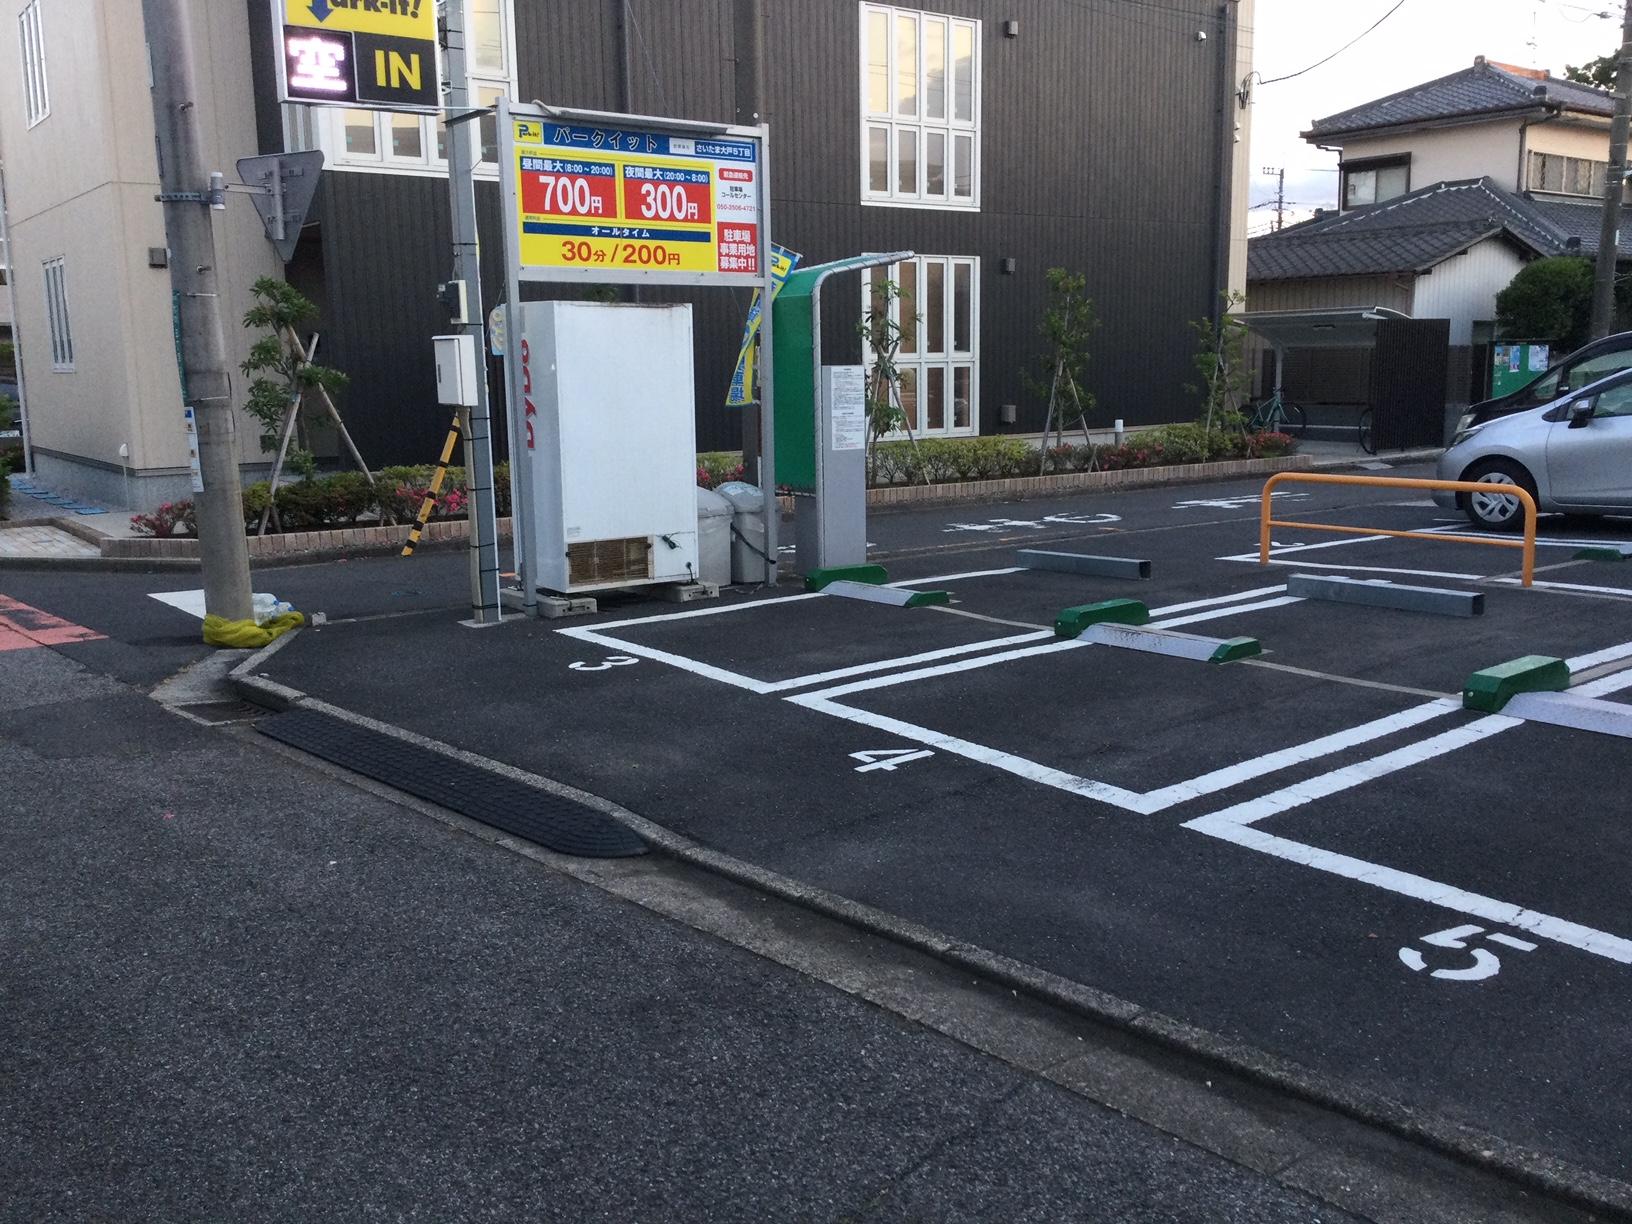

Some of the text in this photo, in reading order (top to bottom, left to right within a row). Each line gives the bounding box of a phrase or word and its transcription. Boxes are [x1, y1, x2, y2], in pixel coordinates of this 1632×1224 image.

[287, 36, 348, 91] 空
[374, 48, 423, 91] IN
[554, 126, 658, 152] パークイット
[591, 226, 650, 238] オールタイム
[723, 229, 751, 242] 駐車場
[719, 242, 756, 257] 事業用地
[568, 655, 640, 671] 3
[847, 748, 936, 773] 4
[1398, 923, 1539, 981] 5
